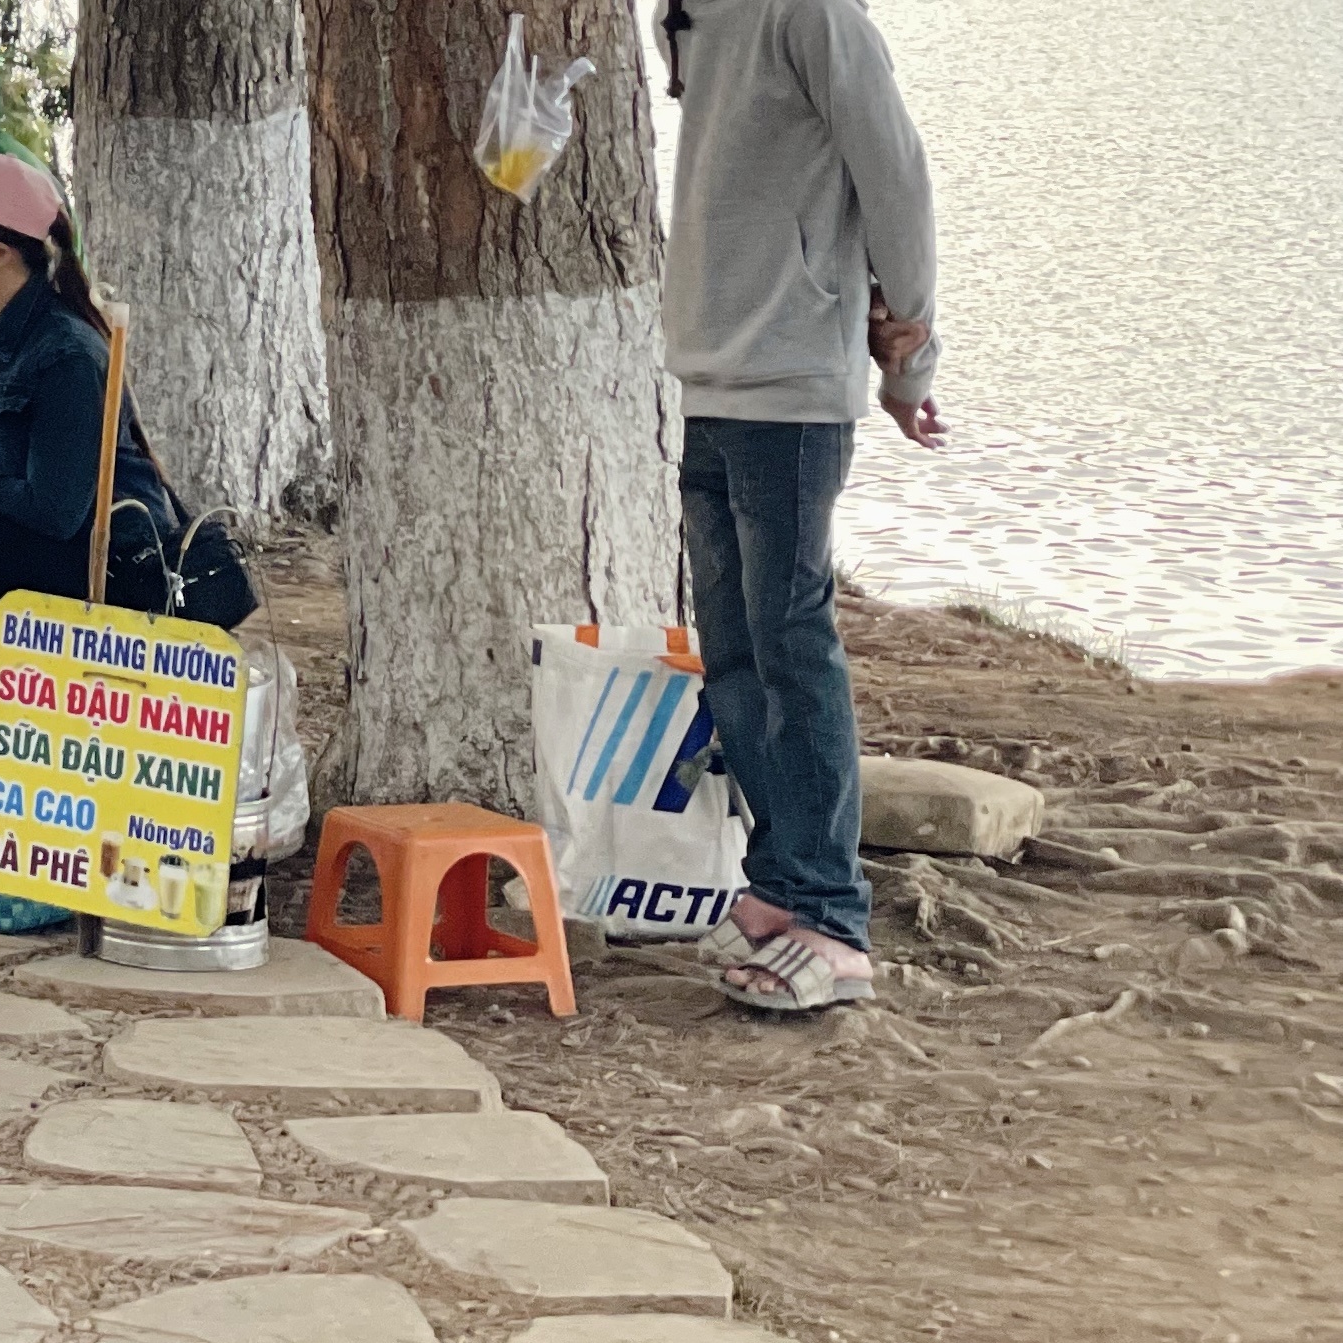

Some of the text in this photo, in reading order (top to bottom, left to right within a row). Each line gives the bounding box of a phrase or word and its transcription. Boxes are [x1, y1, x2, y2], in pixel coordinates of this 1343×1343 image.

[3, 611, 237, 689] BÁNH TRÁNG NƯỚNG
[67, 681, 130, 727] ĐẬU
[140, 695, 231, 745] NÀNH
[61, 737, 126, 783] ĐẬU
[133, 753, 222, 802] XANH
[34, 789, 96, 832] CAO
[127, 814, 216, 856] Nóng/Đá
[29, 844, 91, 889] PHÊ
[606, 878, 750, 926] ACTI
